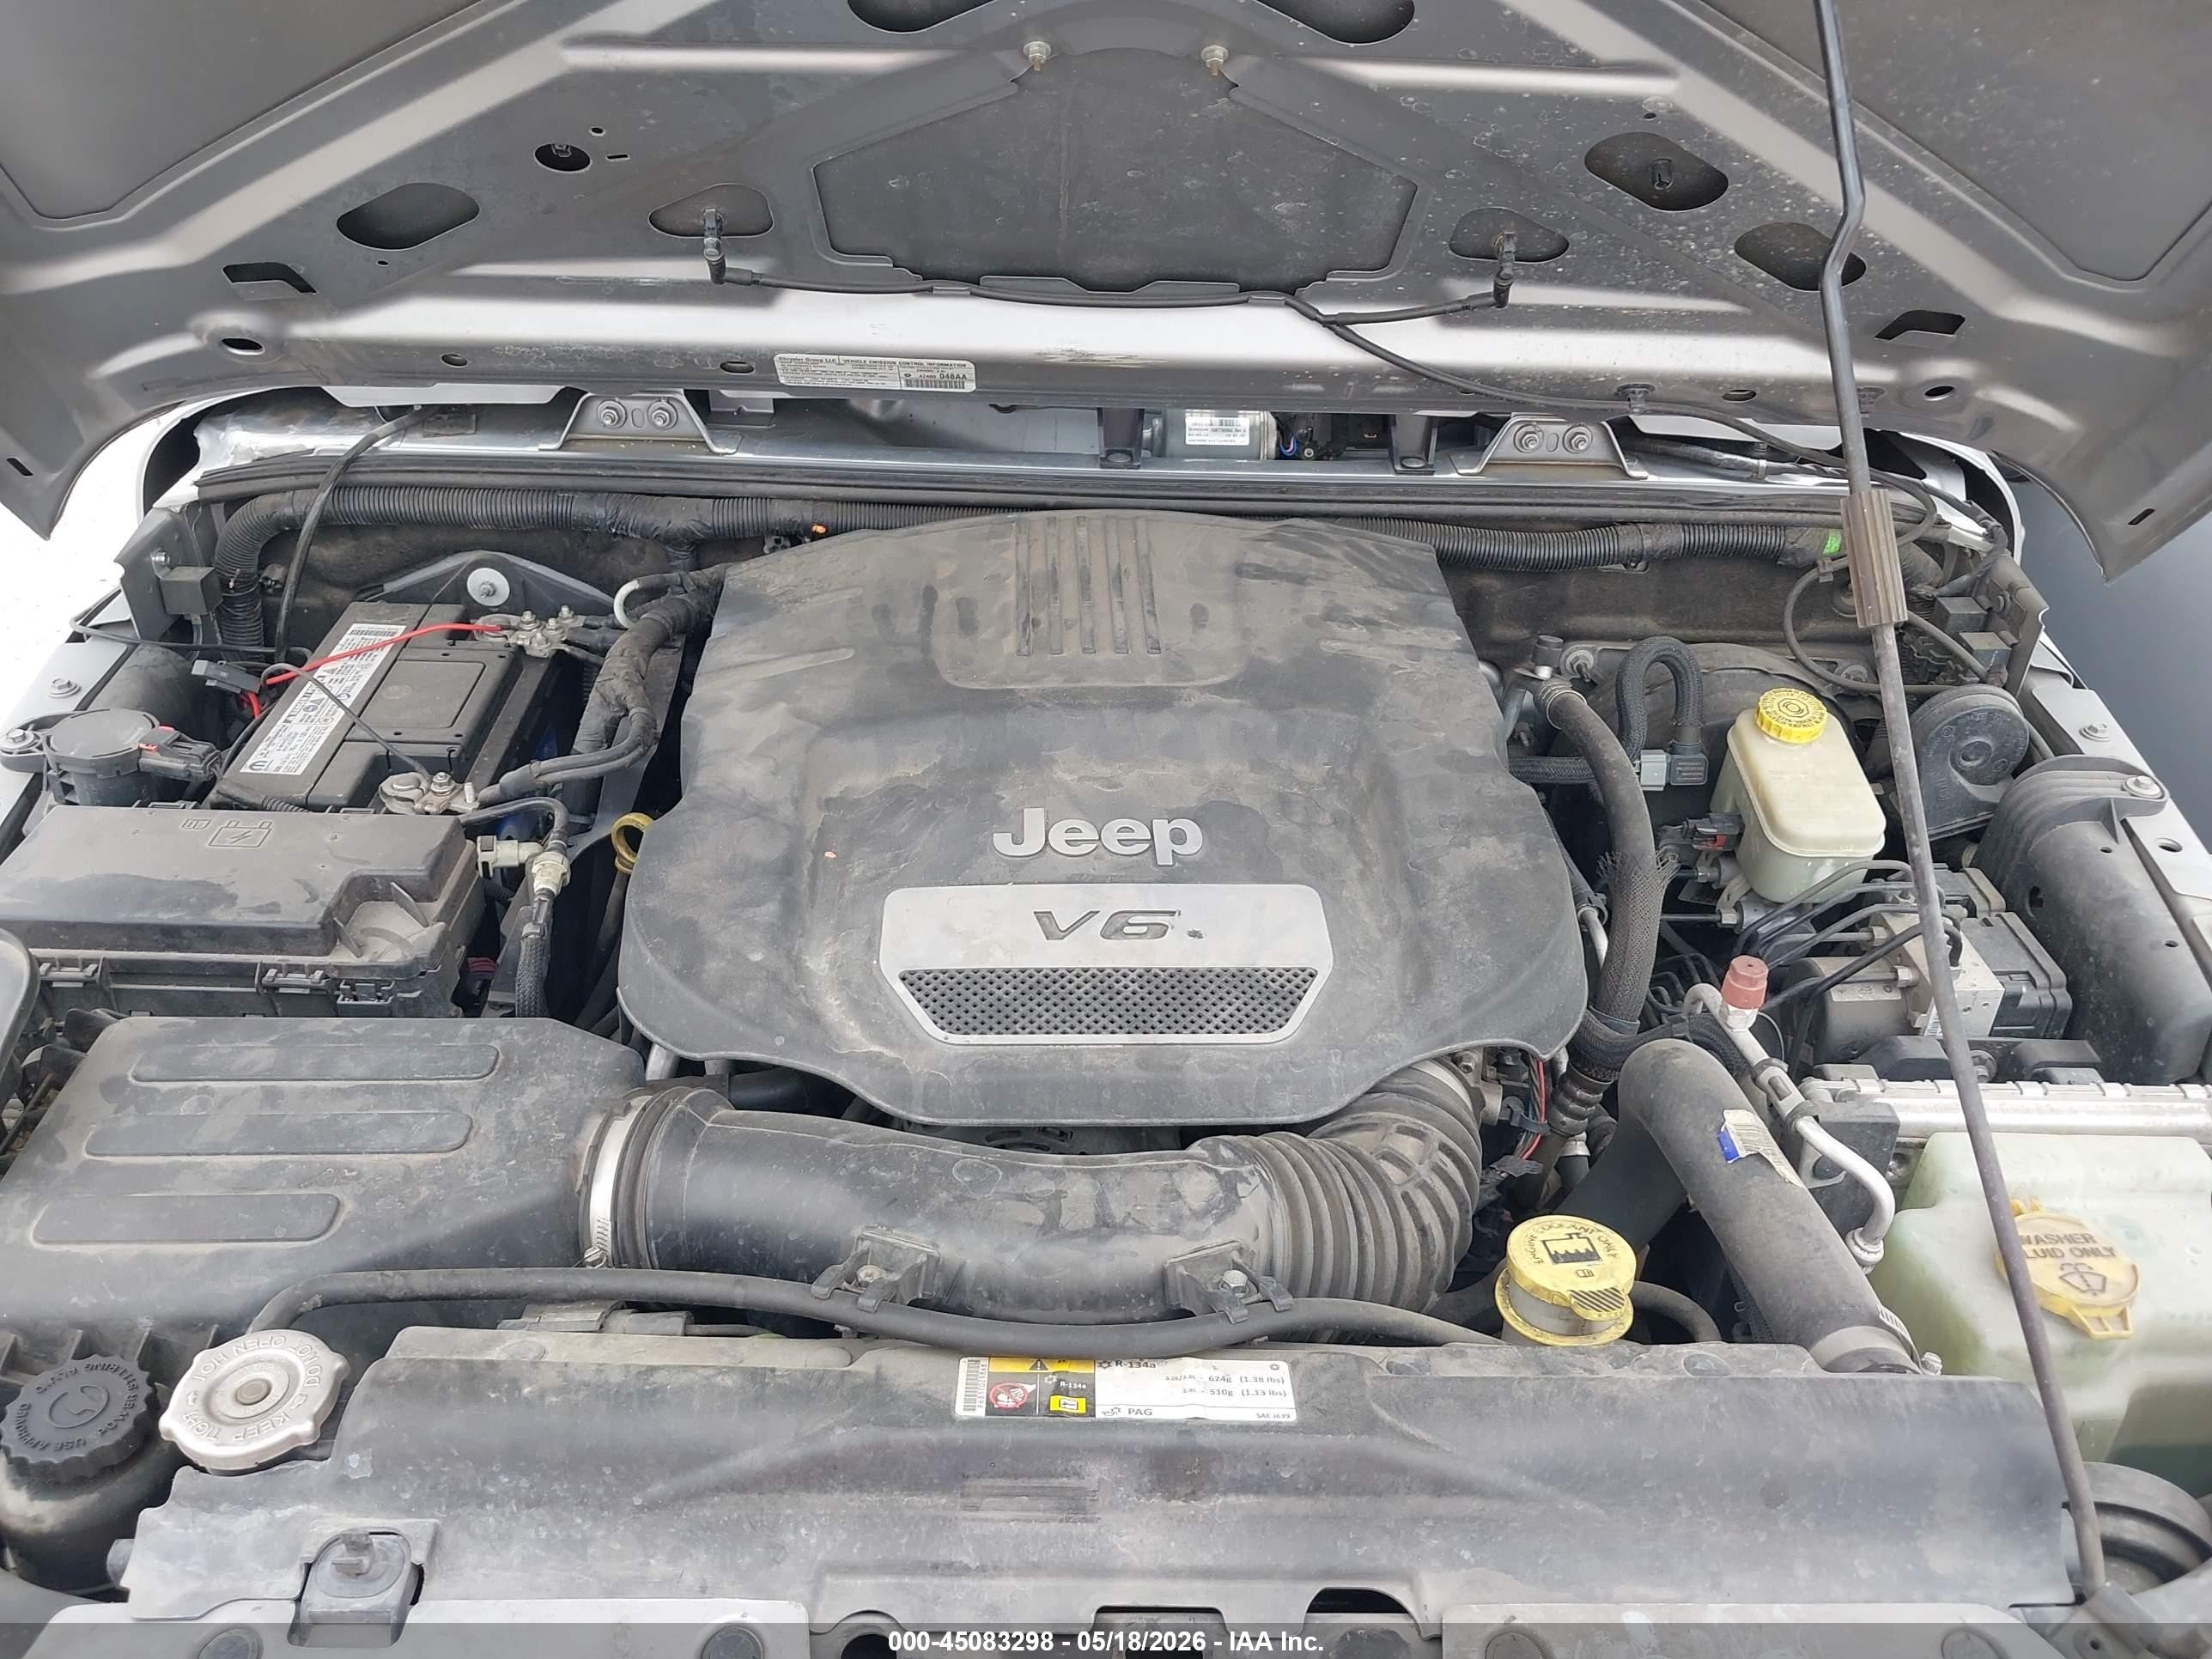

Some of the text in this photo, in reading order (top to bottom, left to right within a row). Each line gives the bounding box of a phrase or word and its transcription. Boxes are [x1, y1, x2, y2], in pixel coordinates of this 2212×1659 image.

[992, 808, 1204, 866] Jeep
[1524, 1234, 1544, 1265] ENGINE
[1597, 1235, 1620, 1259] ONLY
[2024, 1246, 2118, 1259] LUID ONLY
[232, 1335, 287, 1356] OPEN
[193, 1352, 228, 1382] HOT
[1115, 1360, 1156, 1369] R-134a
[1060, 1381, 1087, 1389] R-134a
[1267, 1376, 1285, 1384] lbs)
[1209, 1389, 1234, 1397] 510g
[1268, 1389, 1287, 1397] lbs)
[1127, 1407, 1153, 1416] PAG
[182, 1411, 289, 1442] KEEP TIGHT
